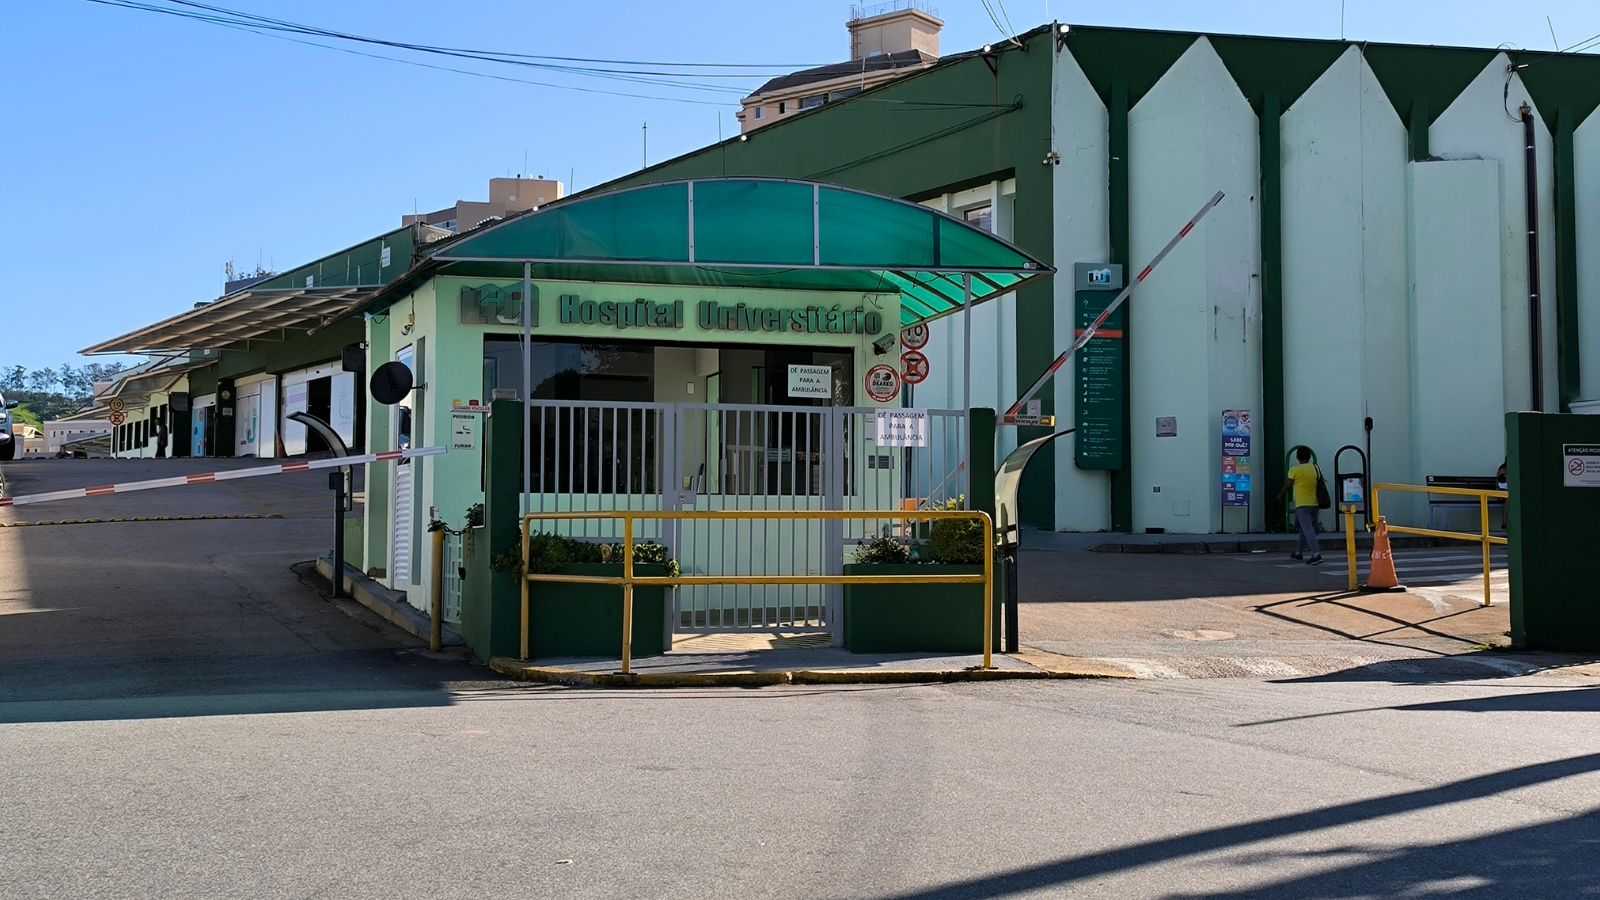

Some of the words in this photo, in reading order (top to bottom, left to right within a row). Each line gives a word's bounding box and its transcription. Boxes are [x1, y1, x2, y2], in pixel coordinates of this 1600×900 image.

[560, 294, 684, 329] Hospital
[698, 300, 882, 335] Universitário
[889, 411, 925, 419] PASSAGEM
